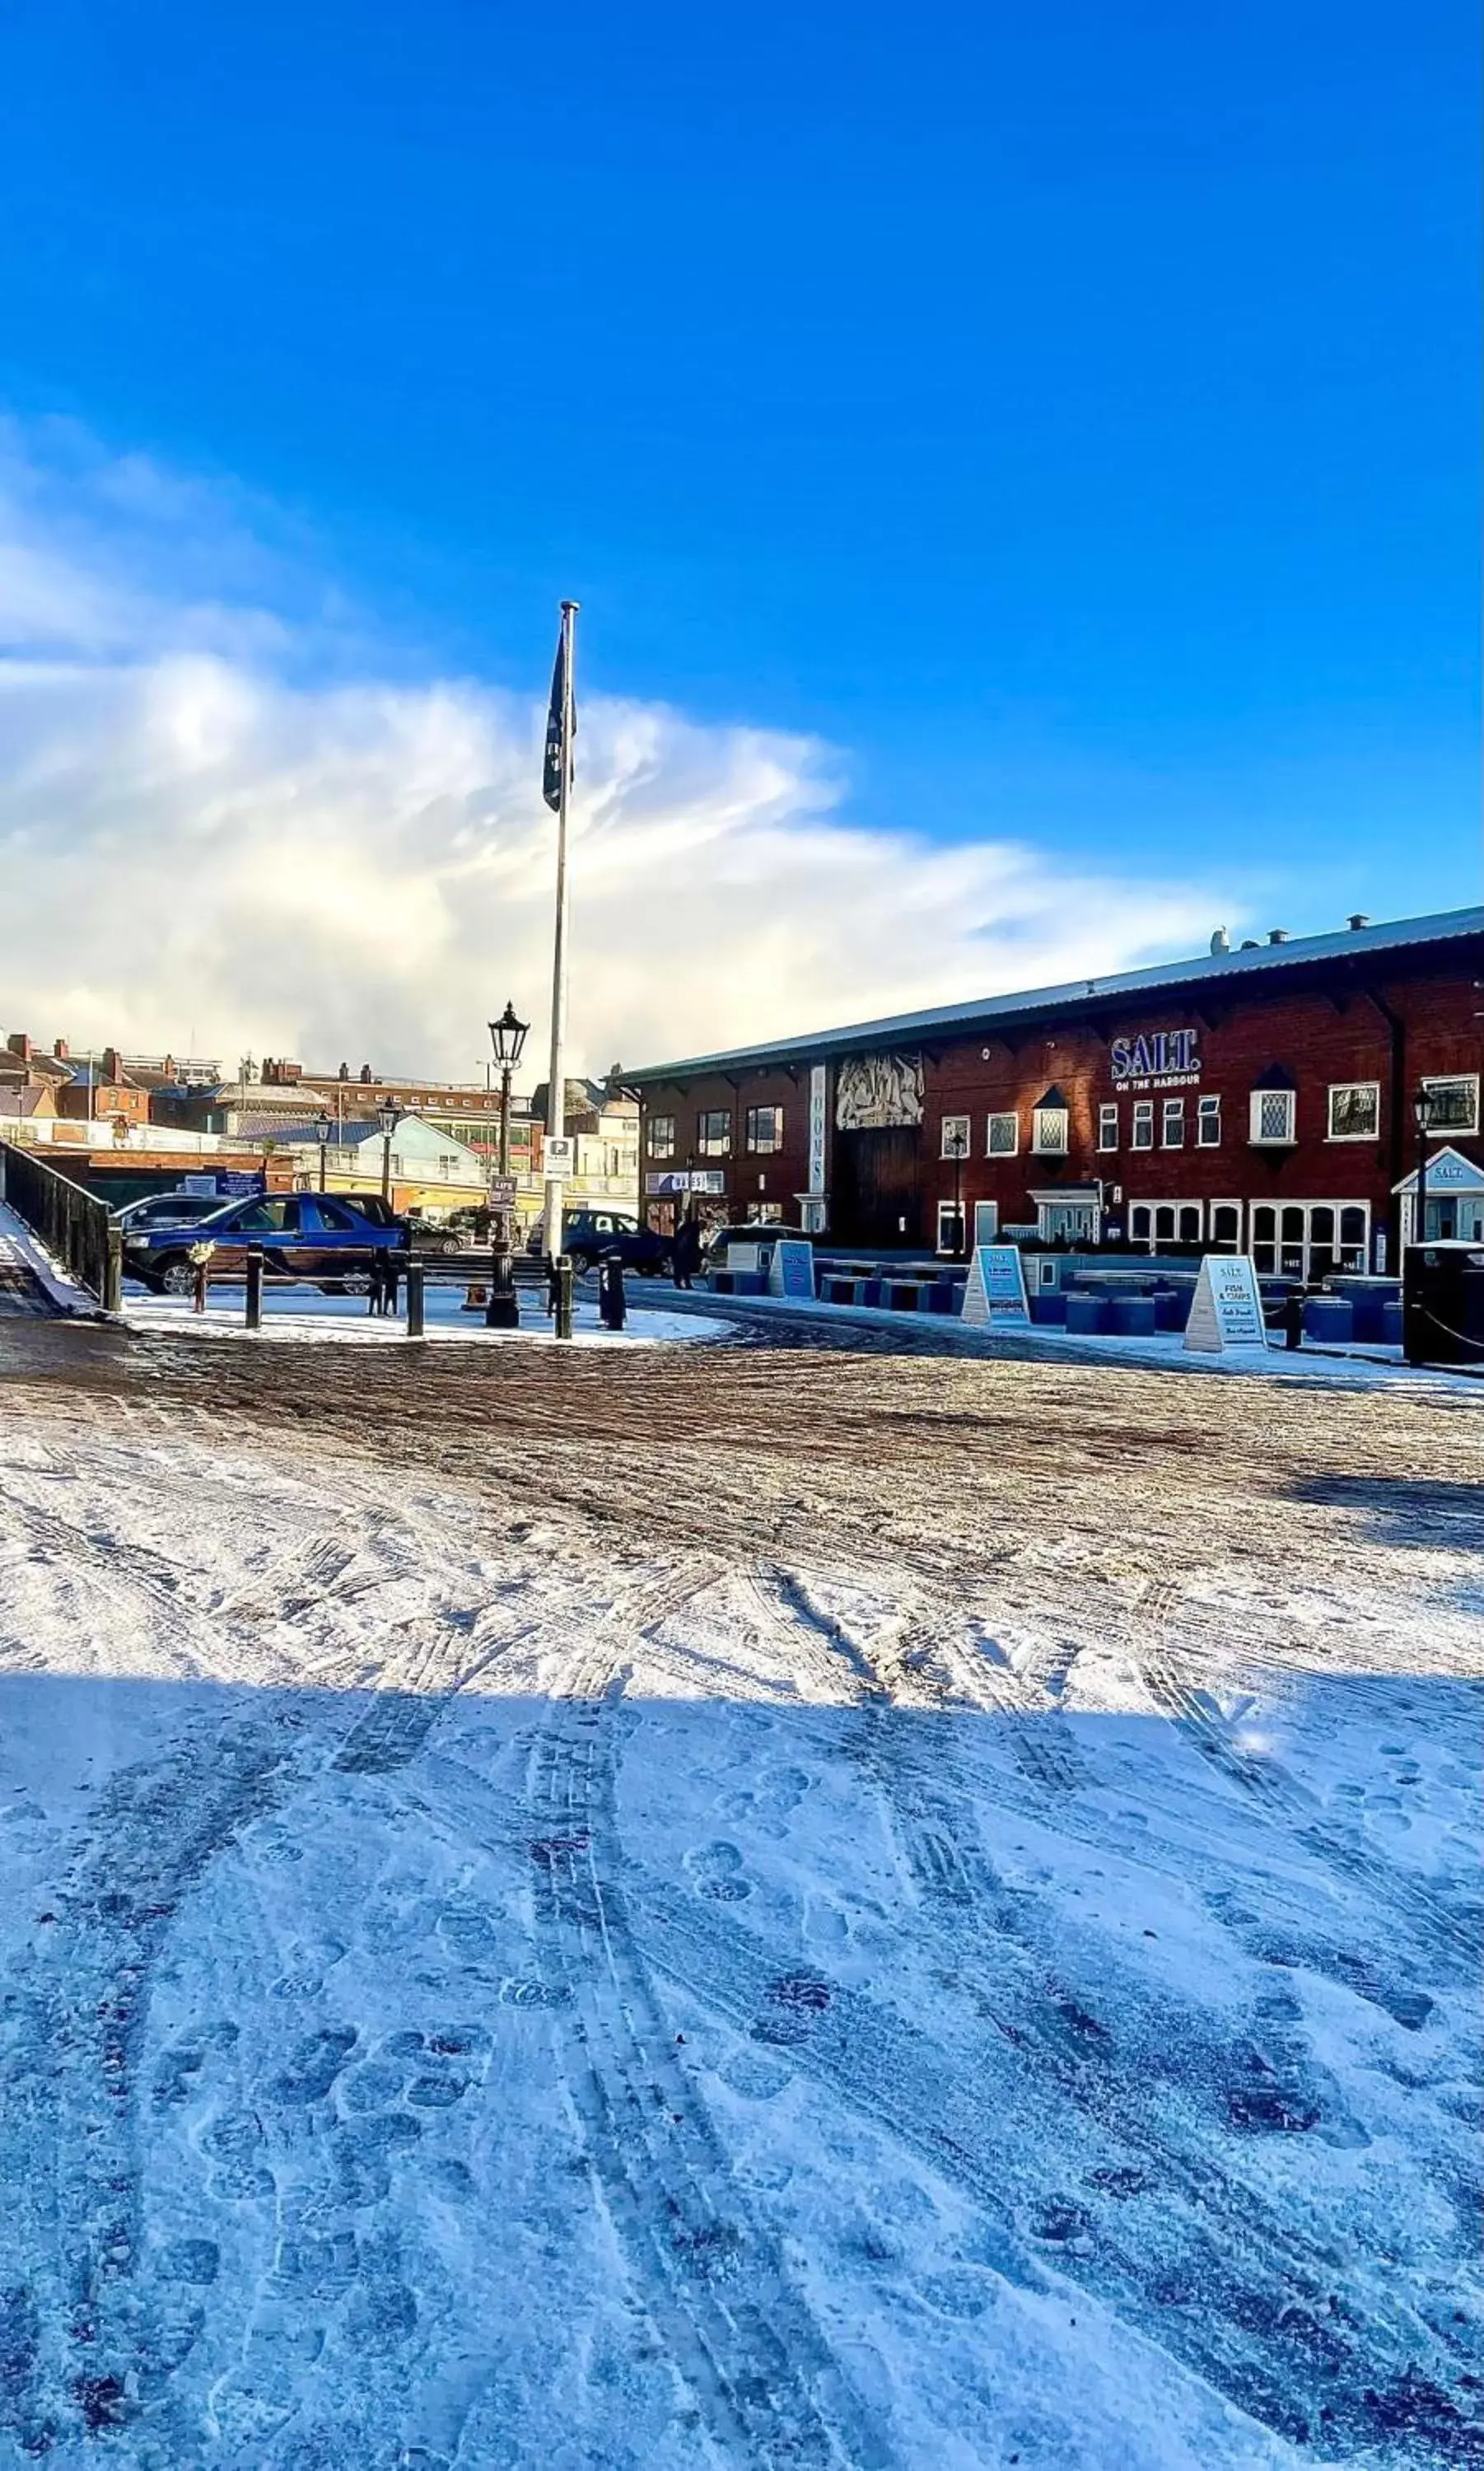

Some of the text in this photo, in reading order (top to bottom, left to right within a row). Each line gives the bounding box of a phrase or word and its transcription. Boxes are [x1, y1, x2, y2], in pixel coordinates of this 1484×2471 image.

[1116, 1074, 1200, 1091] ON THE HARBOUR
